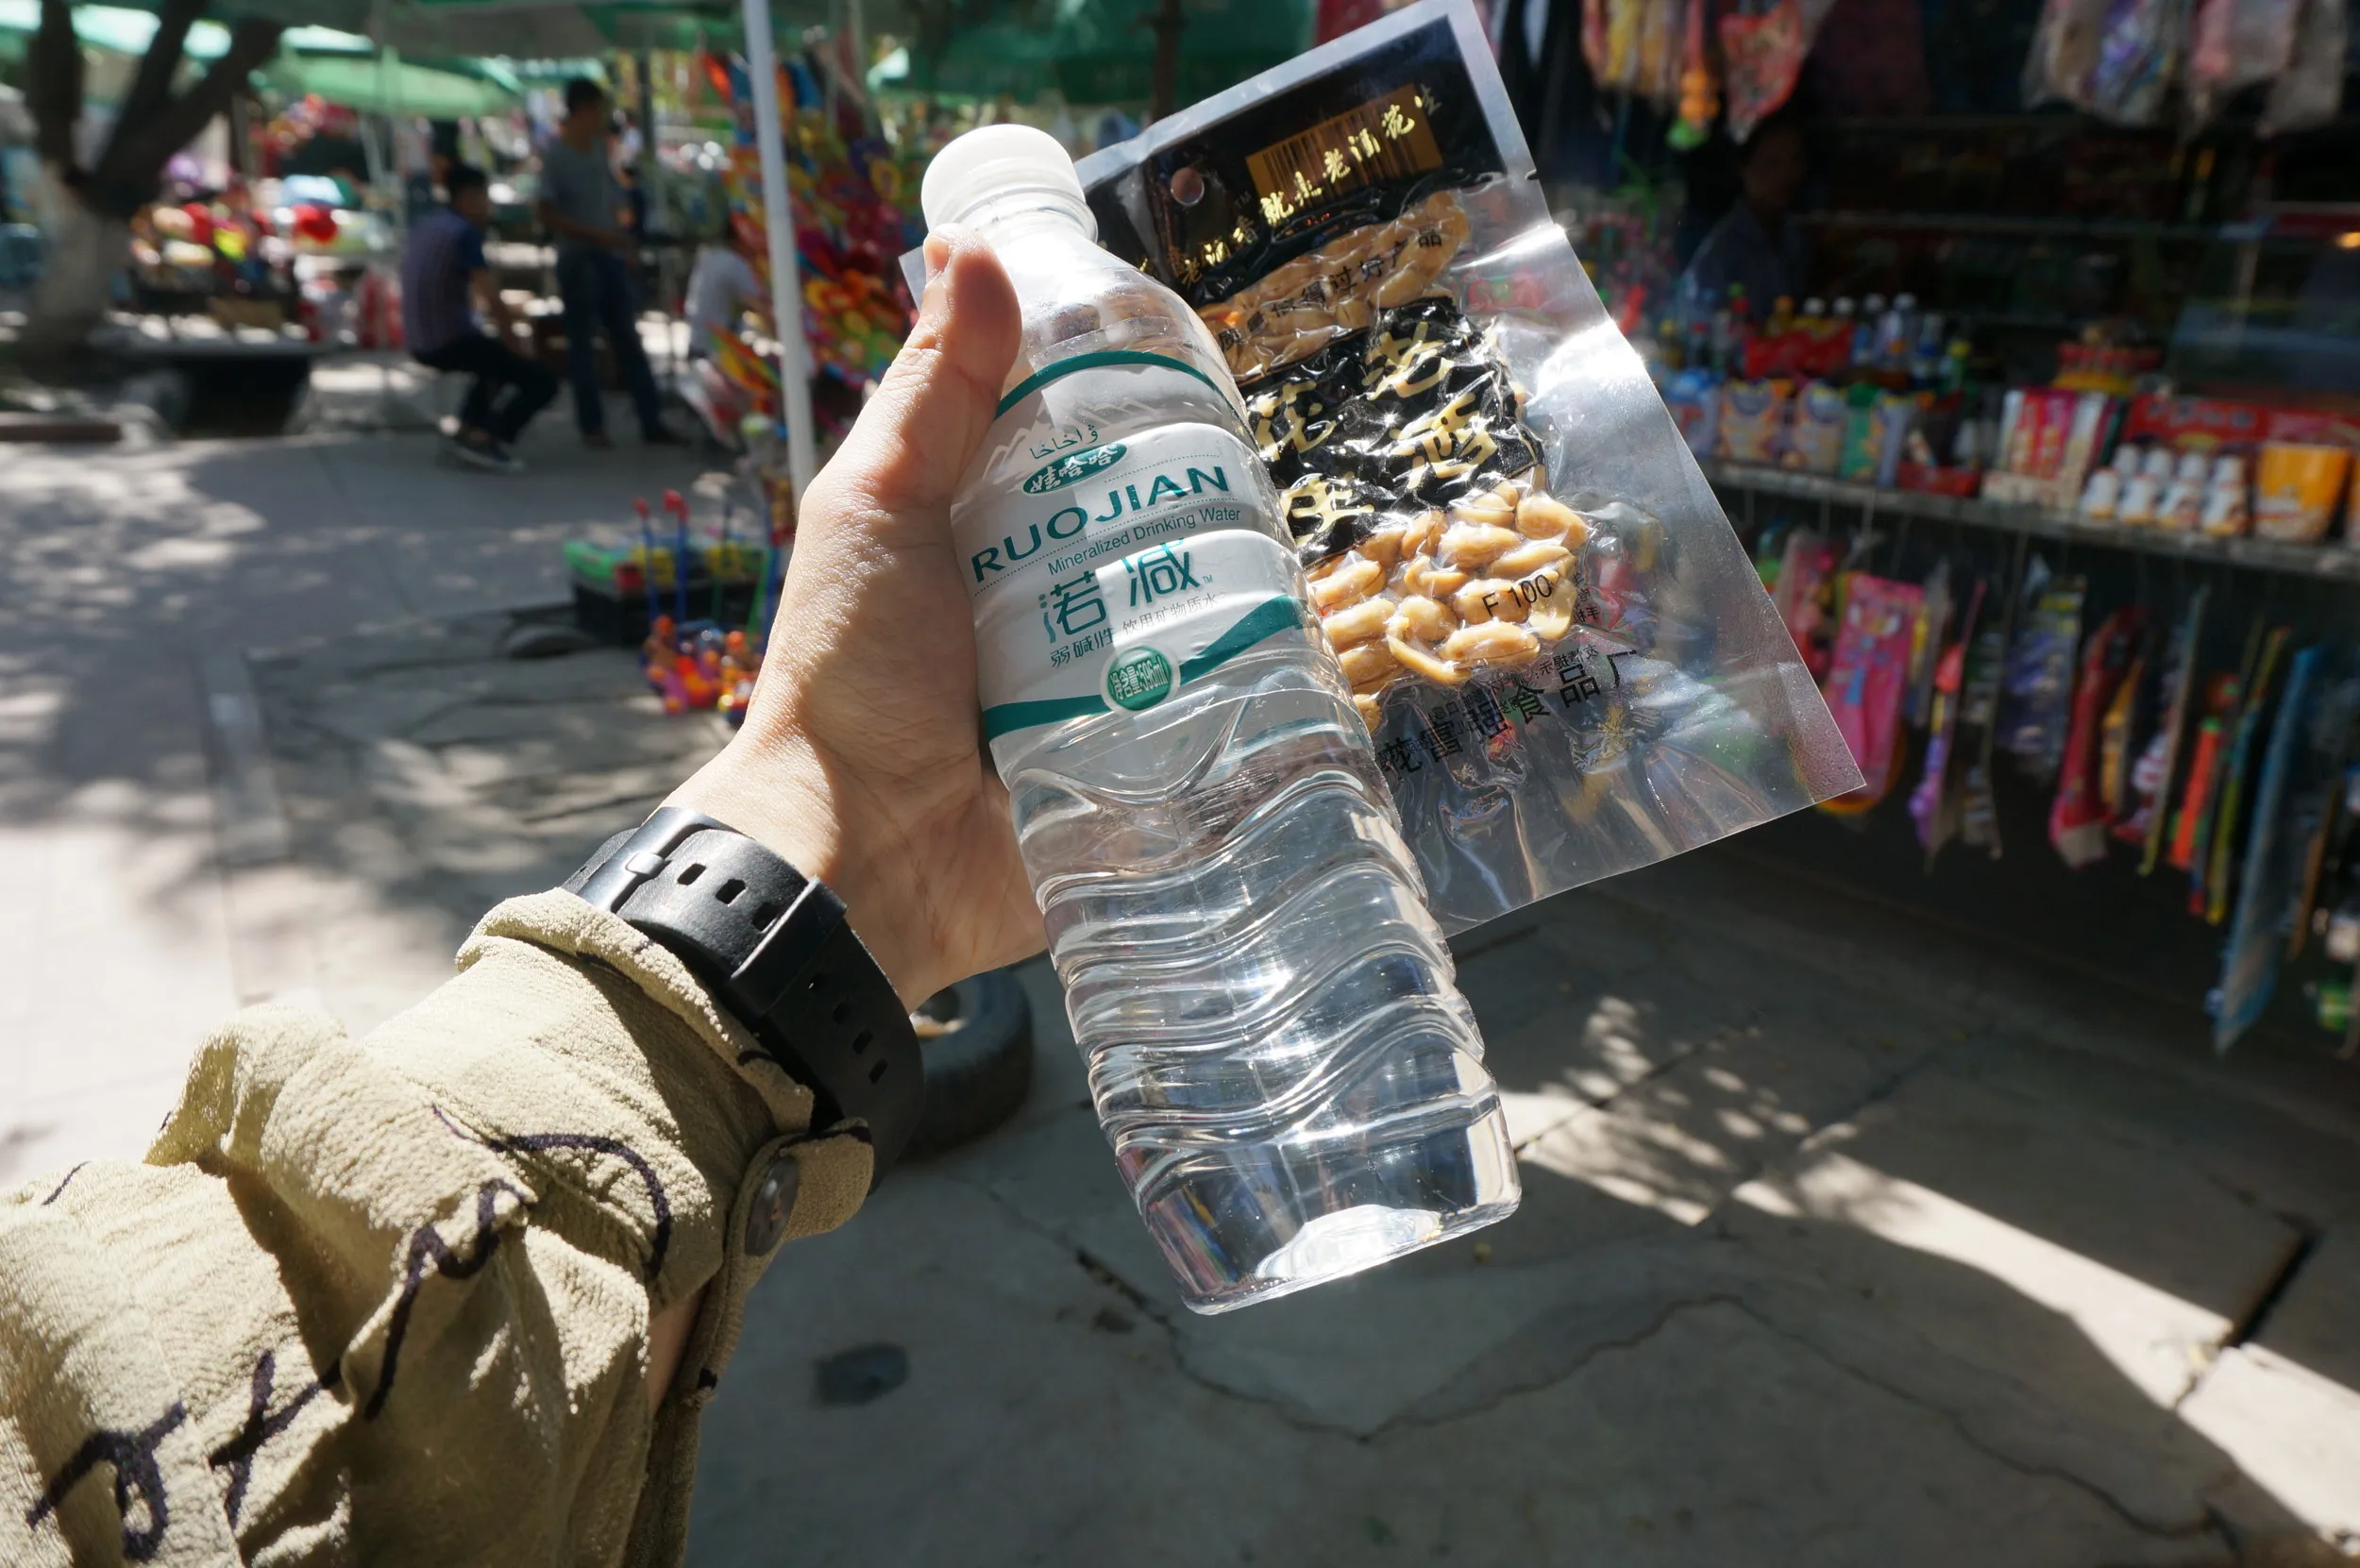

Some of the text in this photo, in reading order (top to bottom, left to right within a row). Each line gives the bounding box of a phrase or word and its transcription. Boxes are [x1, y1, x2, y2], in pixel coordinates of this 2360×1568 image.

[1030, 444, 1119, 493] 娃哈哈
[970, 465, 1230, 583] RUOJIAN
[1048, 507, 1241, 576] Mineralized Drinking Water
[1122, 592, 1218, 635] 饮用矿物质水
[1481, 592, 1499, 617] F
[1508, 573, 1554, 610] 100
